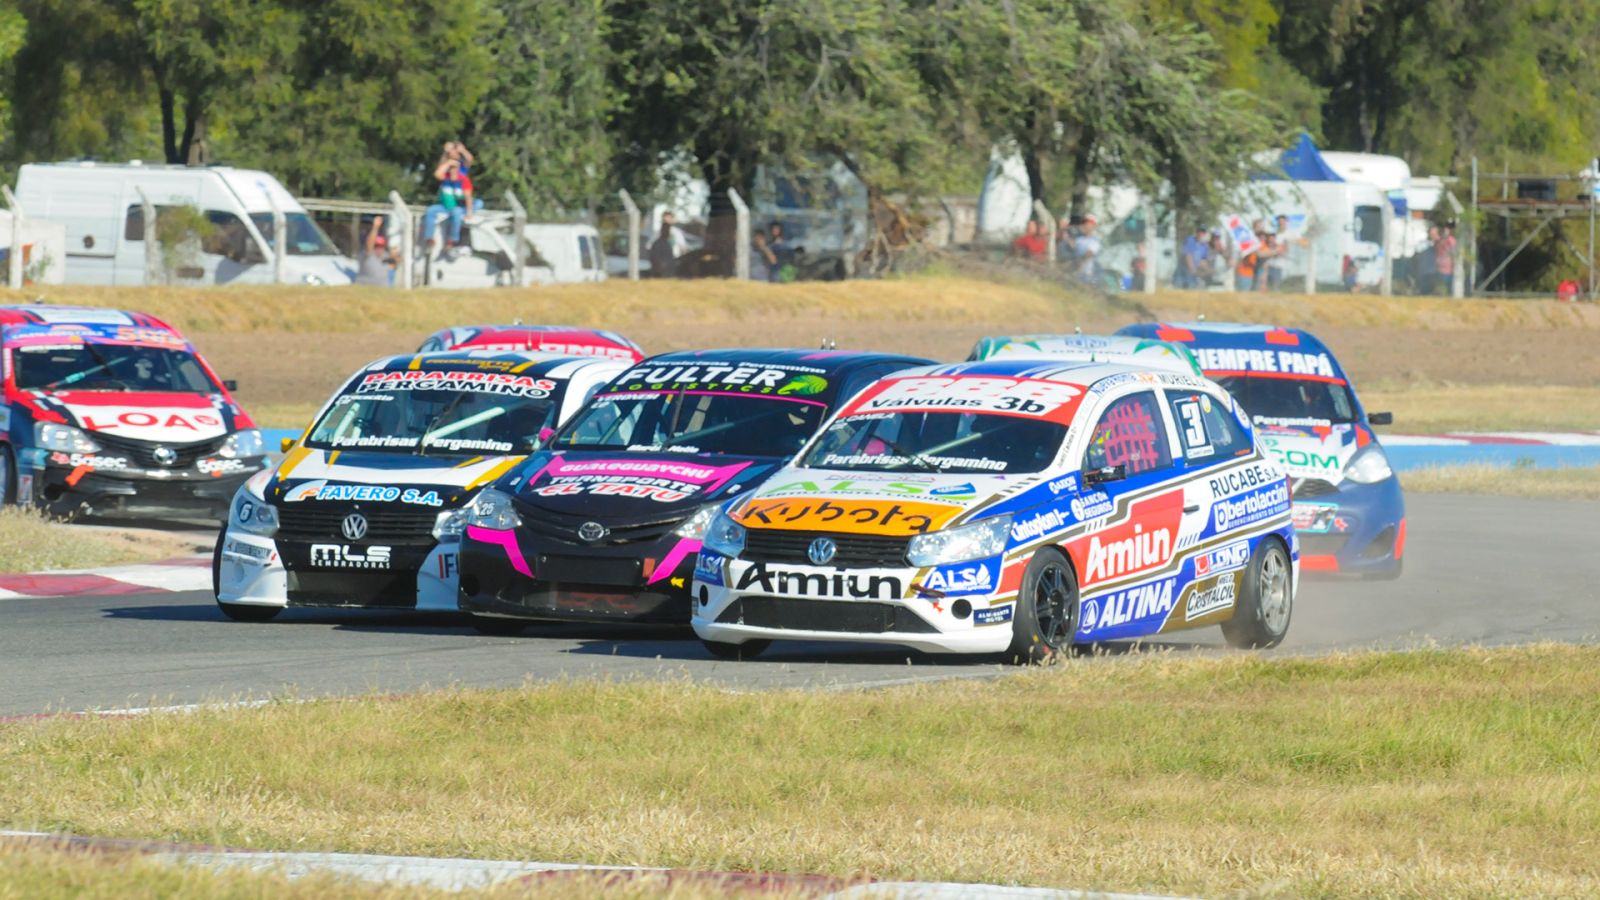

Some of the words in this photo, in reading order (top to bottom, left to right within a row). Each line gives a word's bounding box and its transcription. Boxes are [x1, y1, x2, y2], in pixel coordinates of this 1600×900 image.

[1279, 351, 1334, 376] PAPÁ
[365, 371, 556, 391] PARABRISAS
[616, 367, 786, 387] FULTER
[356, 380, 551, 399] PERGAMINO
[611, 382, 773, 394] LOGISTICS
[1181, 403, 1206, 447] 3
[1254, 415, 1331, 426] Pergamino
[332, 435, 418, 447] Parabrisas
[422, 436, 513, 452] Pergamino
[823, 453, 910, 466] Parabrisas
[912, 454, 1008, 471] Pergamino
[550, 476, 700, 494] TRANSPORTE
[765, 481, 931, 494] ALS
[1210, 466, 1265, 499] RUCABE
[316, 486, 399, 501] FAVERO
[402, 487, 443, 507] S.A.
[590, 483, 697, 502] TATU
[239, 503, 250, 520] 6
[480, 503, 494, 516] 25
[744, 502, 932, 533] Kubota
[310, 544, 393, 562] MLS
[1086, 524, 1172, 583] Amiun
[1209, 541, 1248, 570] LONG
[310, 561, 391, 569] SEMBRADORAS
[735, 561, 902, 600] Amiun
[927, 567, 976, 589] ALS
[1100, 580, 1173, 628] ALTINA
